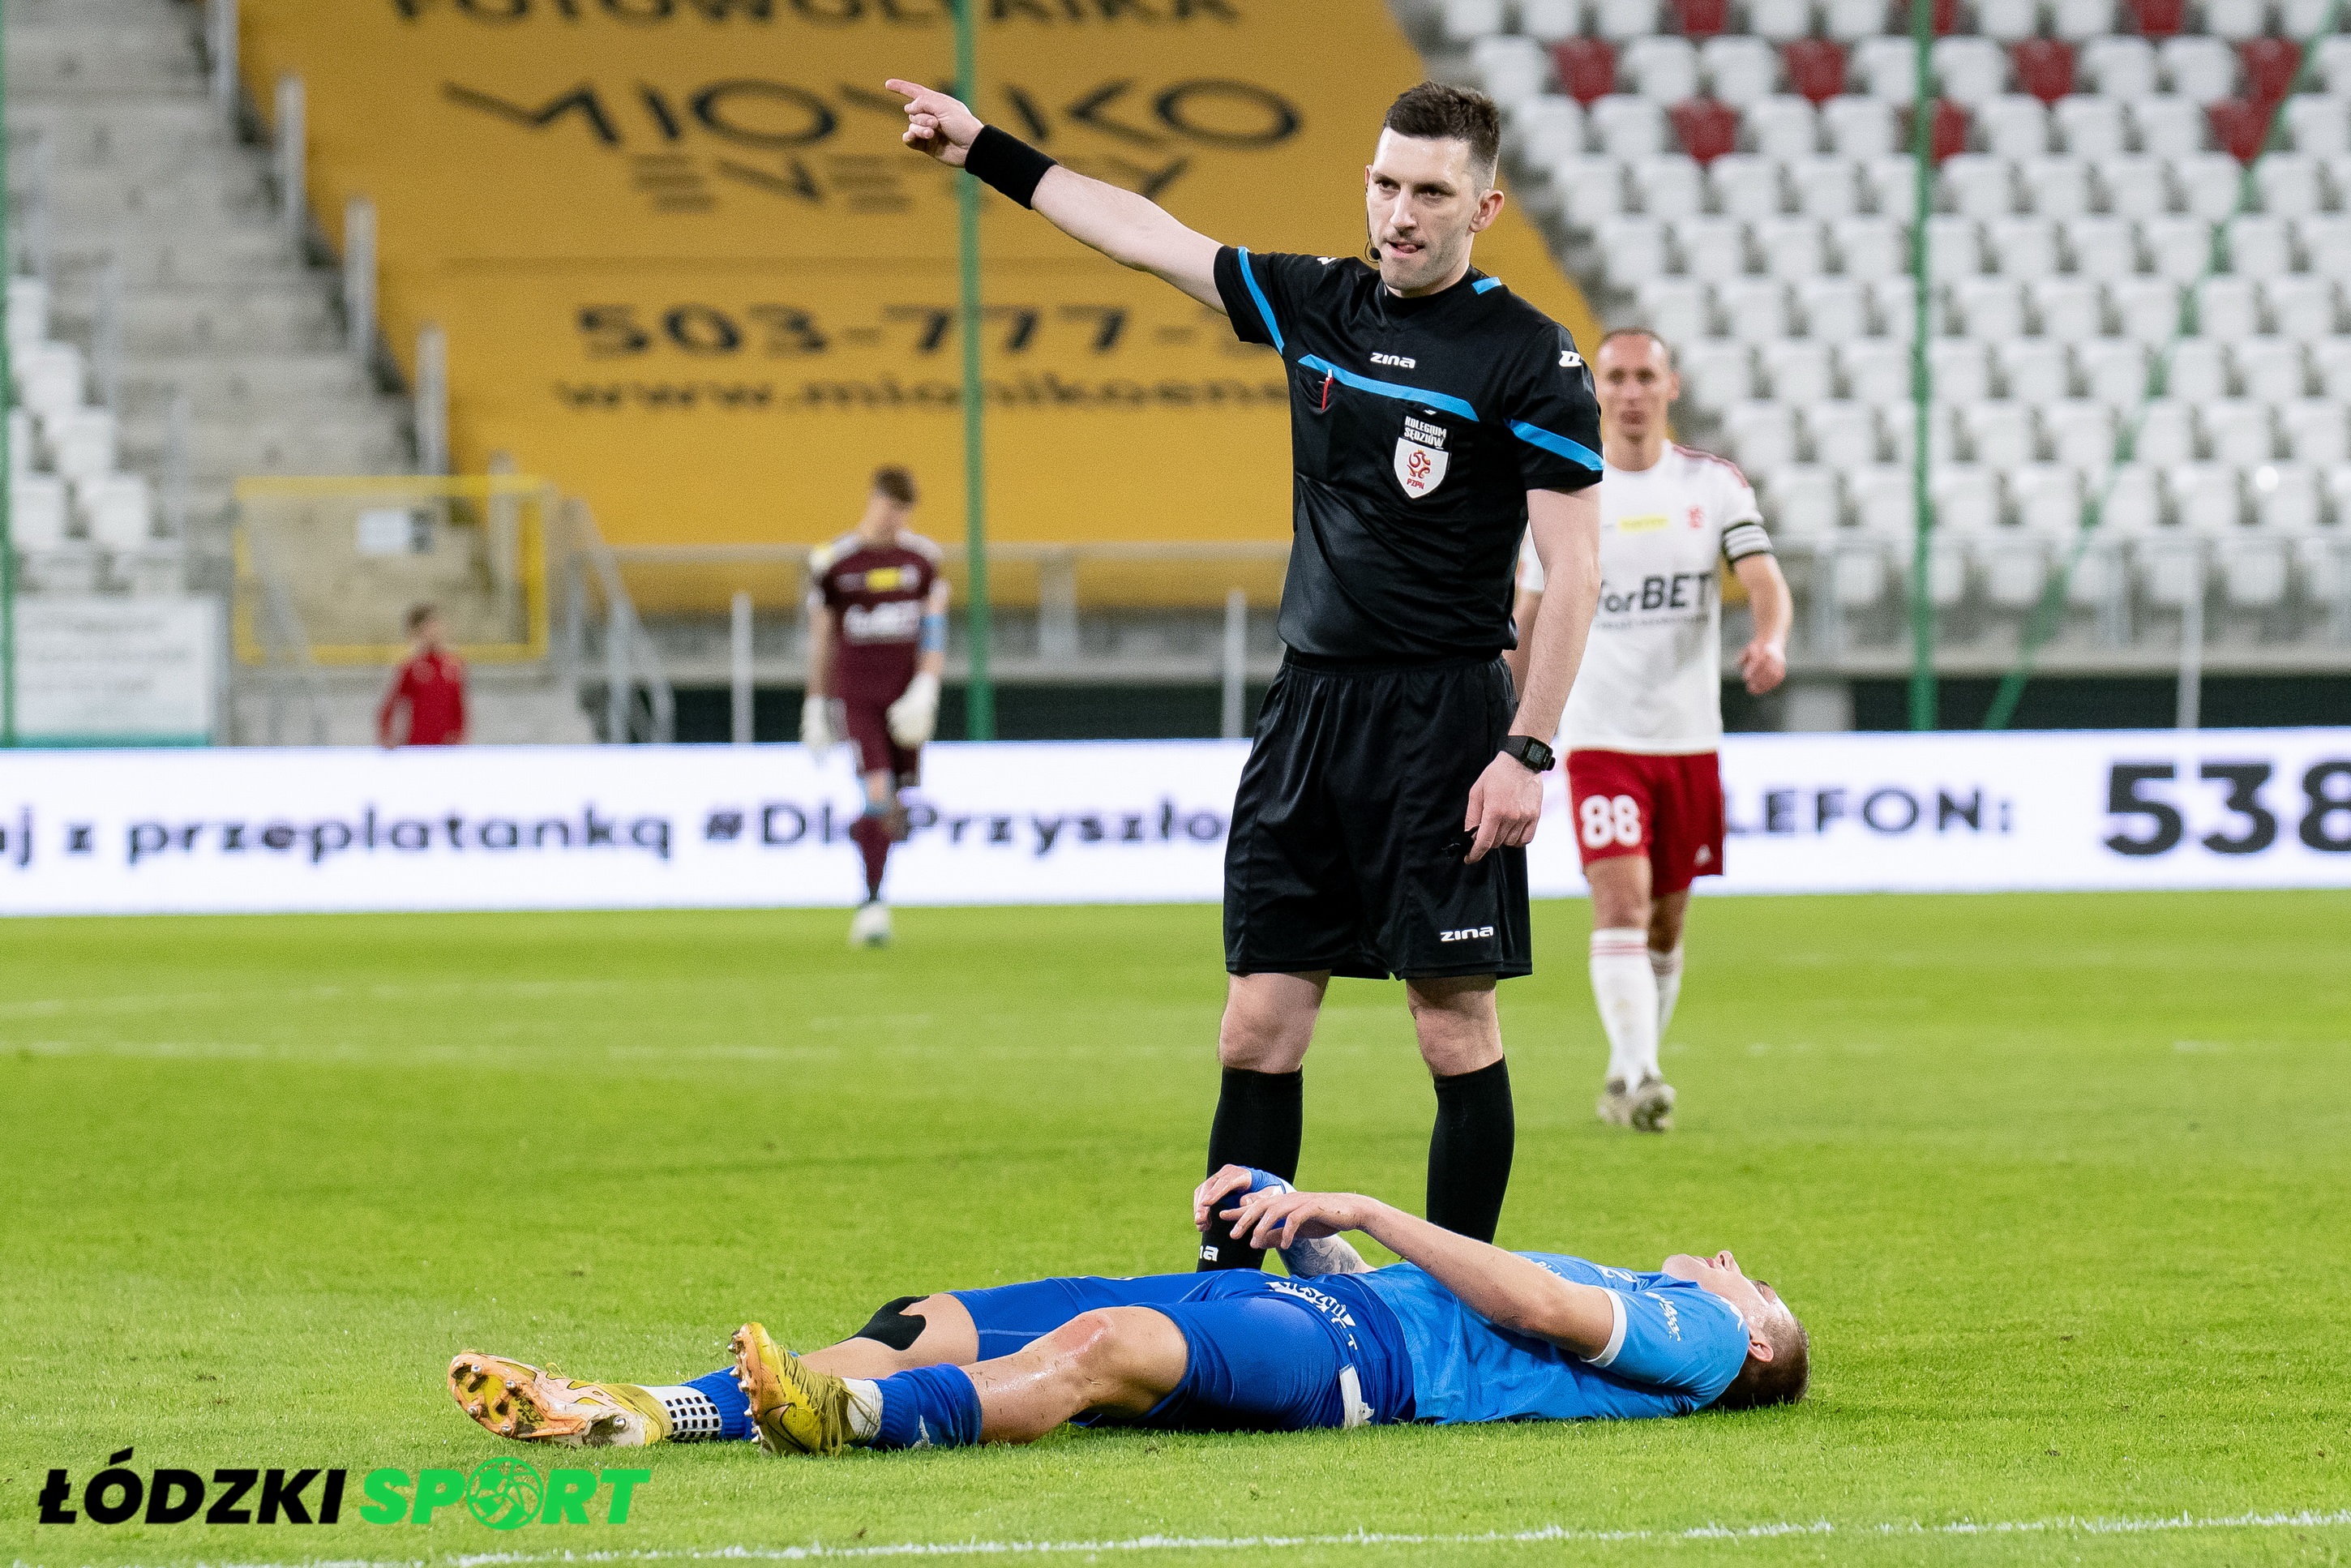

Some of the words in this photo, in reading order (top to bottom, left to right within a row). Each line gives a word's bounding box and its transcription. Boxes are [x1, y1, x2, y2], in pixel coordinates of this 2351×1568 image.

[1403, 426, 1445, 448] SĘDZIÓW
[1404, 415, 1447, 438] KOLEGIUM
[1407, 478, 1425, 490] PZPN
[1601, 571, 1714, 611] orBET
[1579, 795, 1642, 849] 88
[2105, 760, 2351, 855] 538
[130, 805, 671, 866] przeplatanką
[707, 800, 1224, 858] #DlPrzyszło
